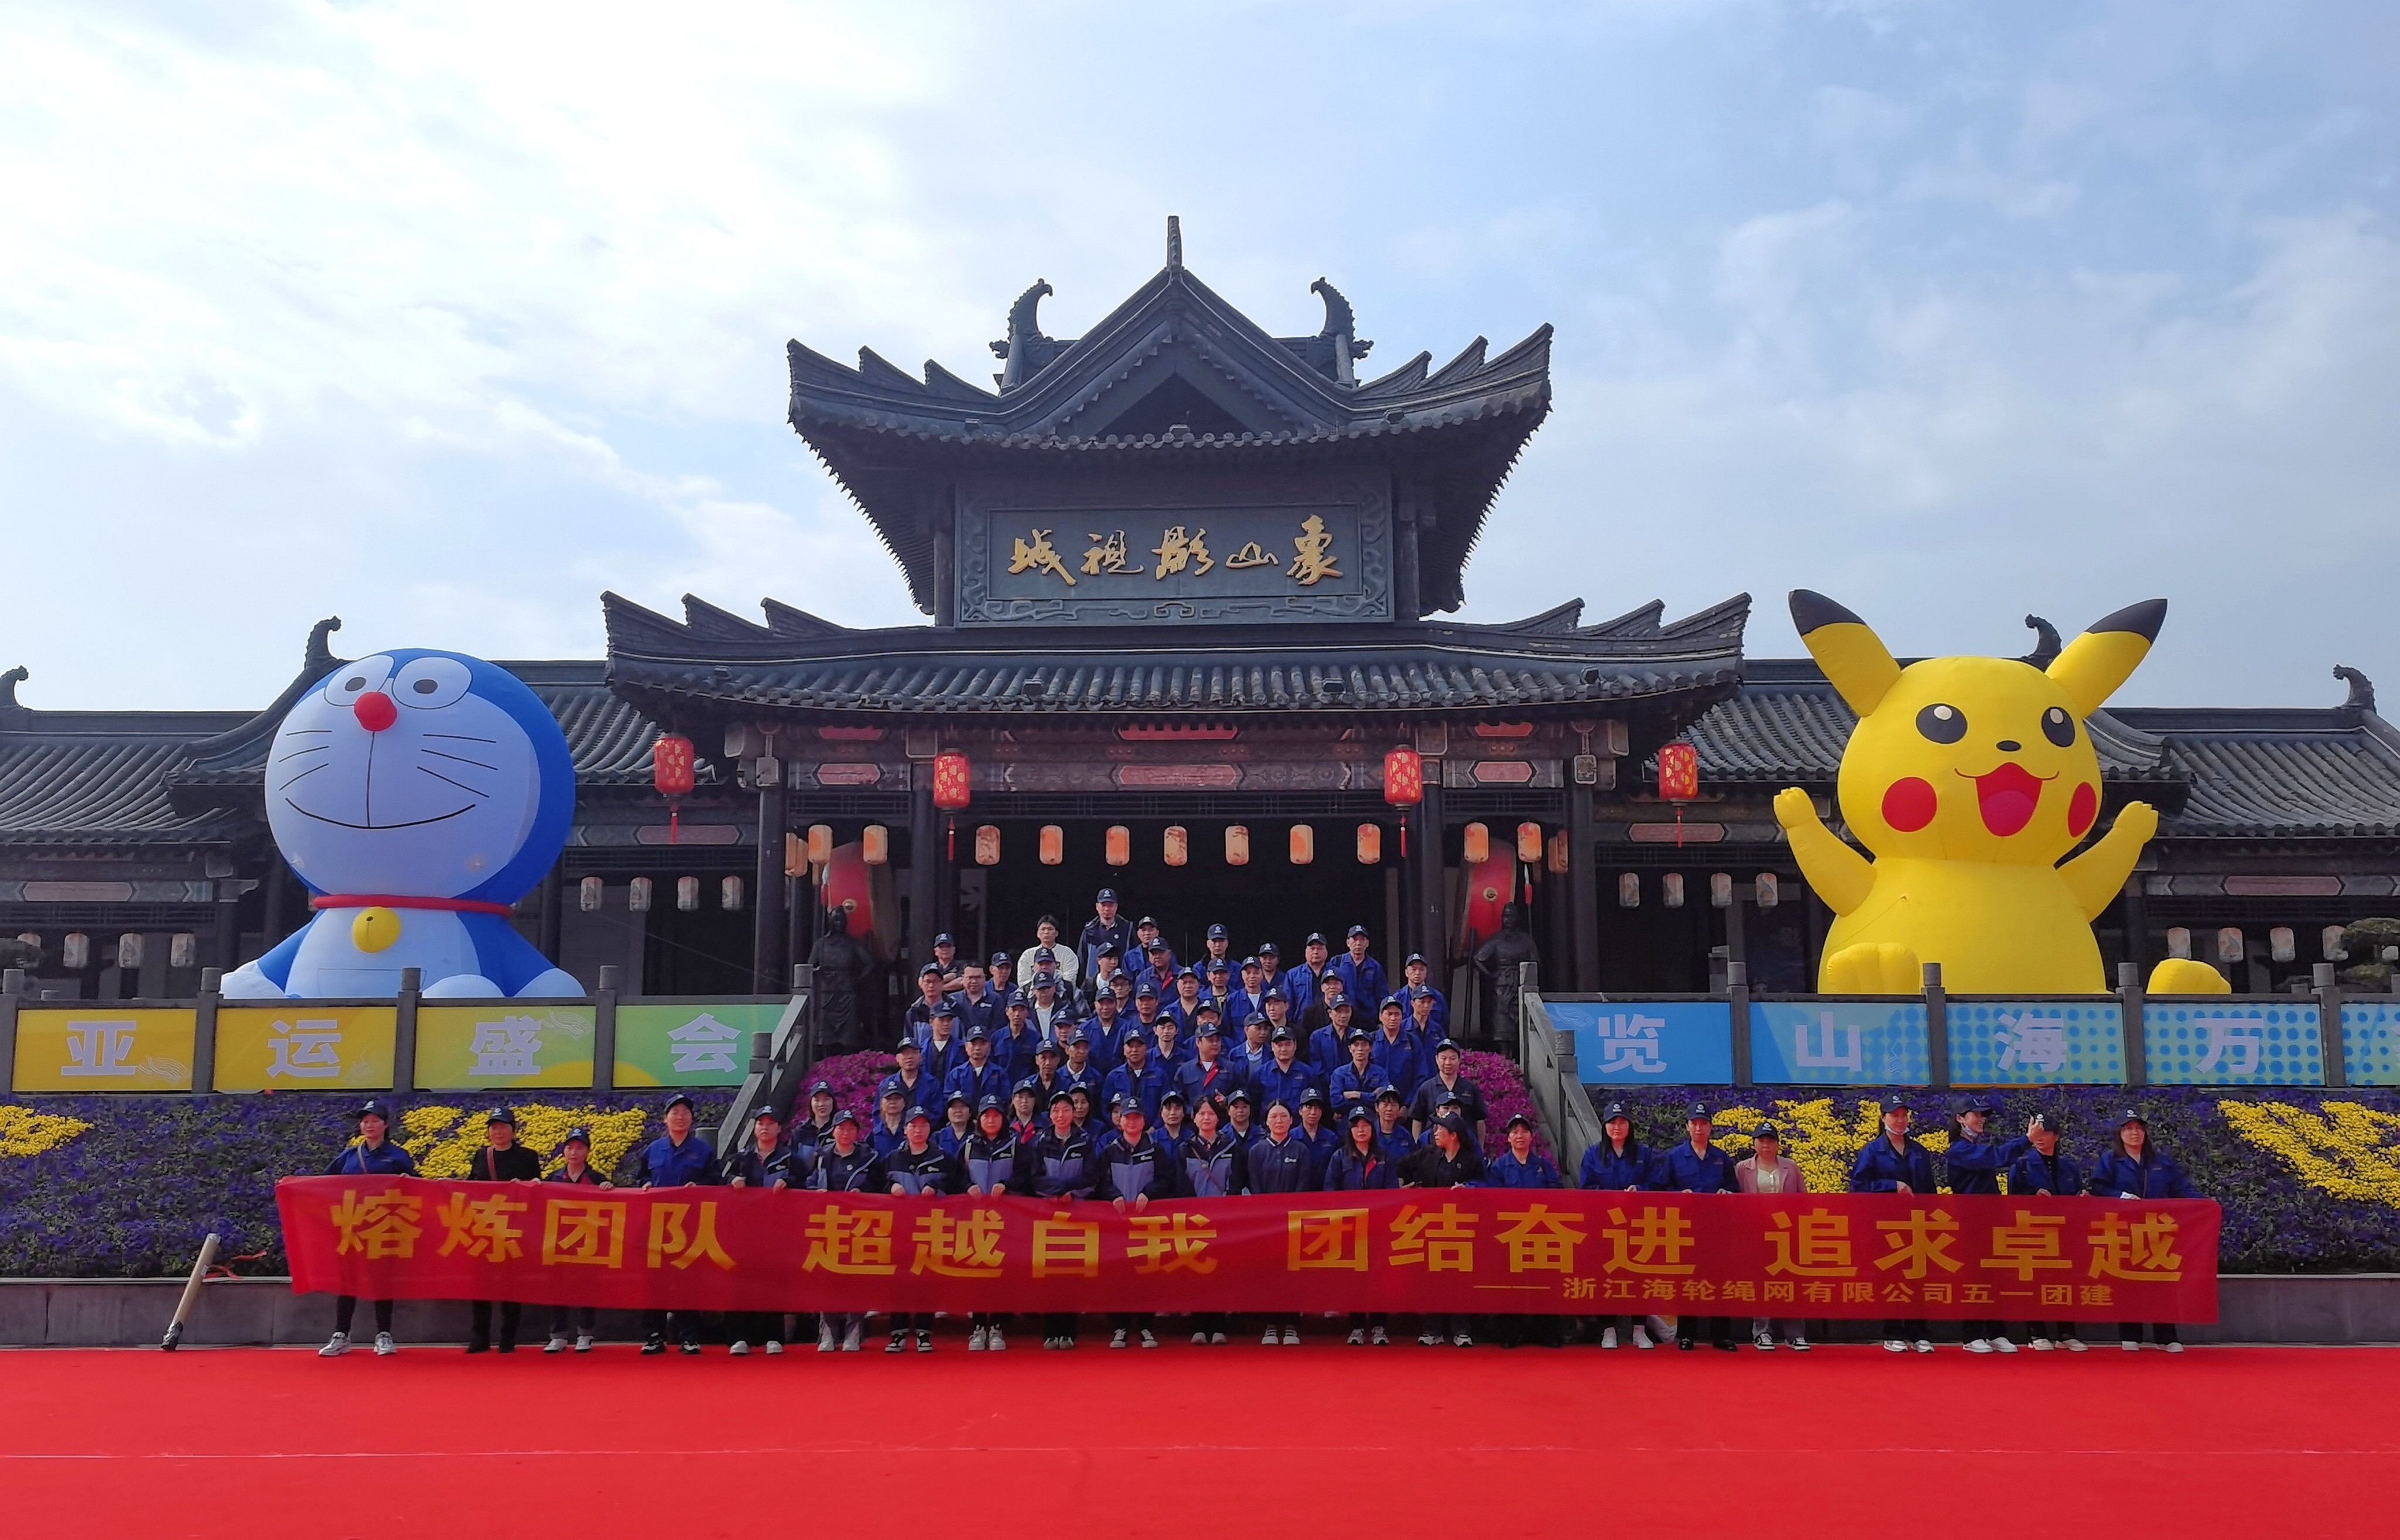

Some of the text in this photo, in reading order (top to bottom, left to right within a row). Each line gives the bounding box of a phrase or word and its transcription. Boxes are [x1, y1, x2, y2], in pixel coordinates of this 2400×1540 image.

[330, 1189, 2182, 1282] 熔炼团队 超越自我 团结奋进 追求卓越
